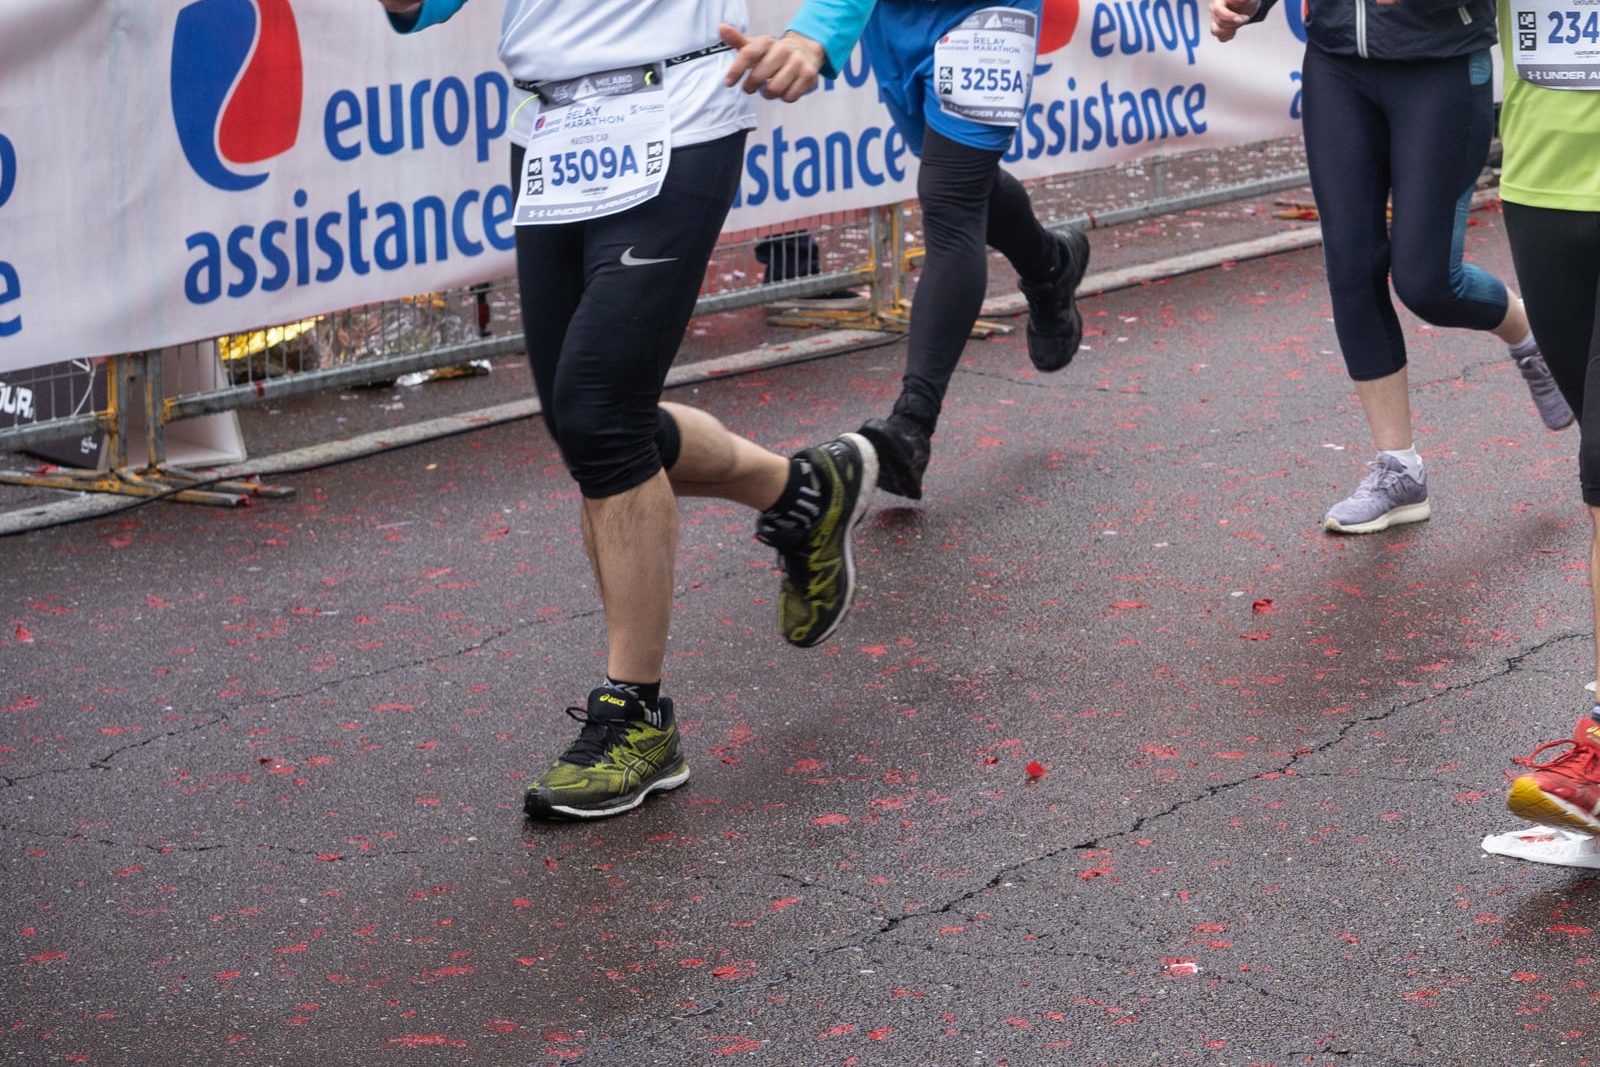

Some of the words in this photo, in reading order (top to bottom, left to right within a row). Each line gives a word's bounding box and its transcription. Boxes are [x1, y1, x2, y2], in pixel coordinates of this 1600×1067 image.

[973, 37, 1006, 46] RELAY
[973, 45, 1020, 54] MARATHON
[596, 74, 633, 86] MILANO
[960, 67, 1024, 94] 3255A
[1543, 71, 1586, 80] UNDER
[323, 70, 507, 164] europ
[564, 115, 625, 129] MARATHON
[566, 105, 602, 120] RELAY
[549, 144, 639, 187] 3509A
[732, 125, 907, 209] stance
[546, 205, 594, 218] UNDER
[595, 189, 649, 212] ARMOUR
[184, 184, 515, 305] assistance
